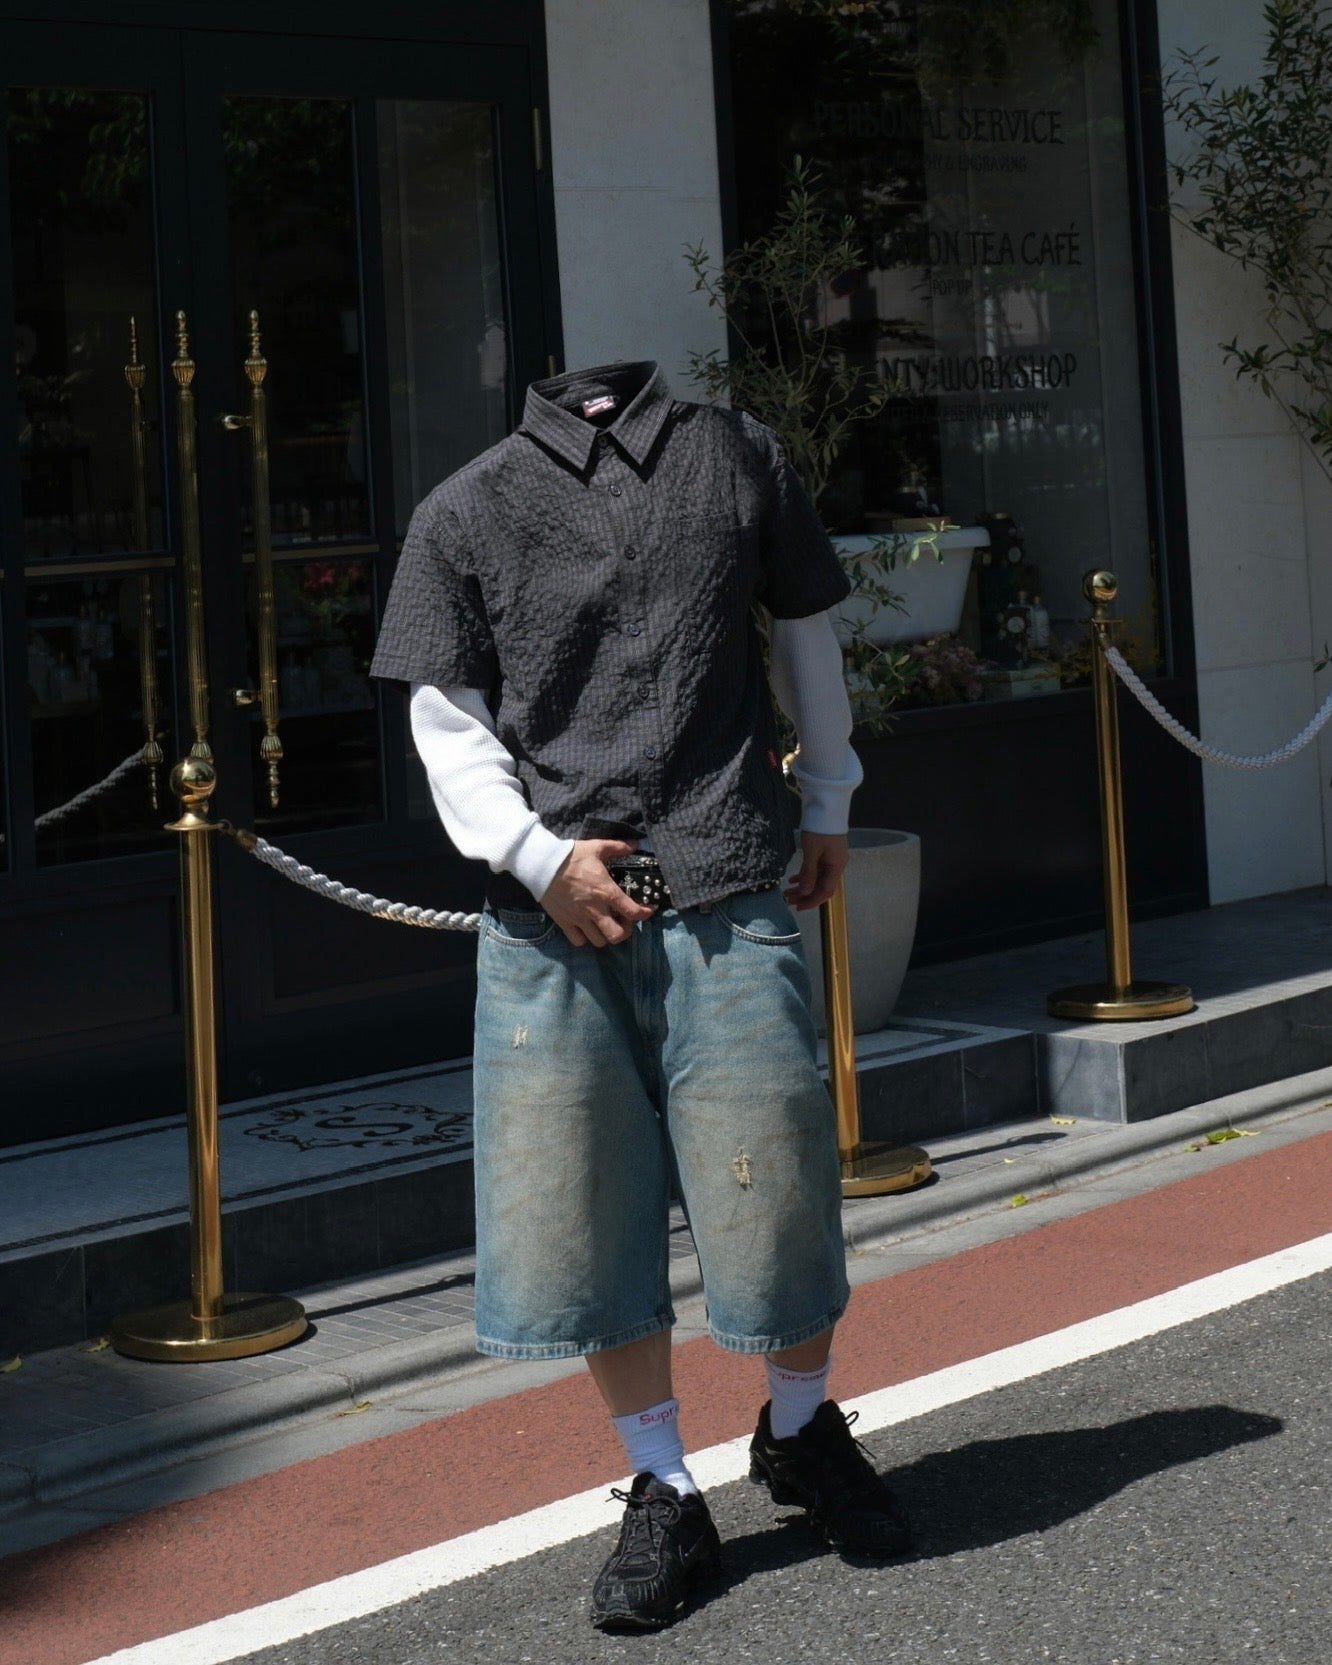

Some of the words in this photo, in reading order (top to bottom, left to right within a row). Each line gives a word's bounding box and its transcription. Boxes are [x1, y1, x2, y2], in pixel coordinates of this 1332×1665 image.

[813, 99, 950, 141] PERSONAL
[958, 106, 1065, 144] SERVICE
[966, 230, 1014, 266] TEA
[1021, 222, 1082, 266] CAFÉ
[939, 352, 1077, 392] WORKSHOP
